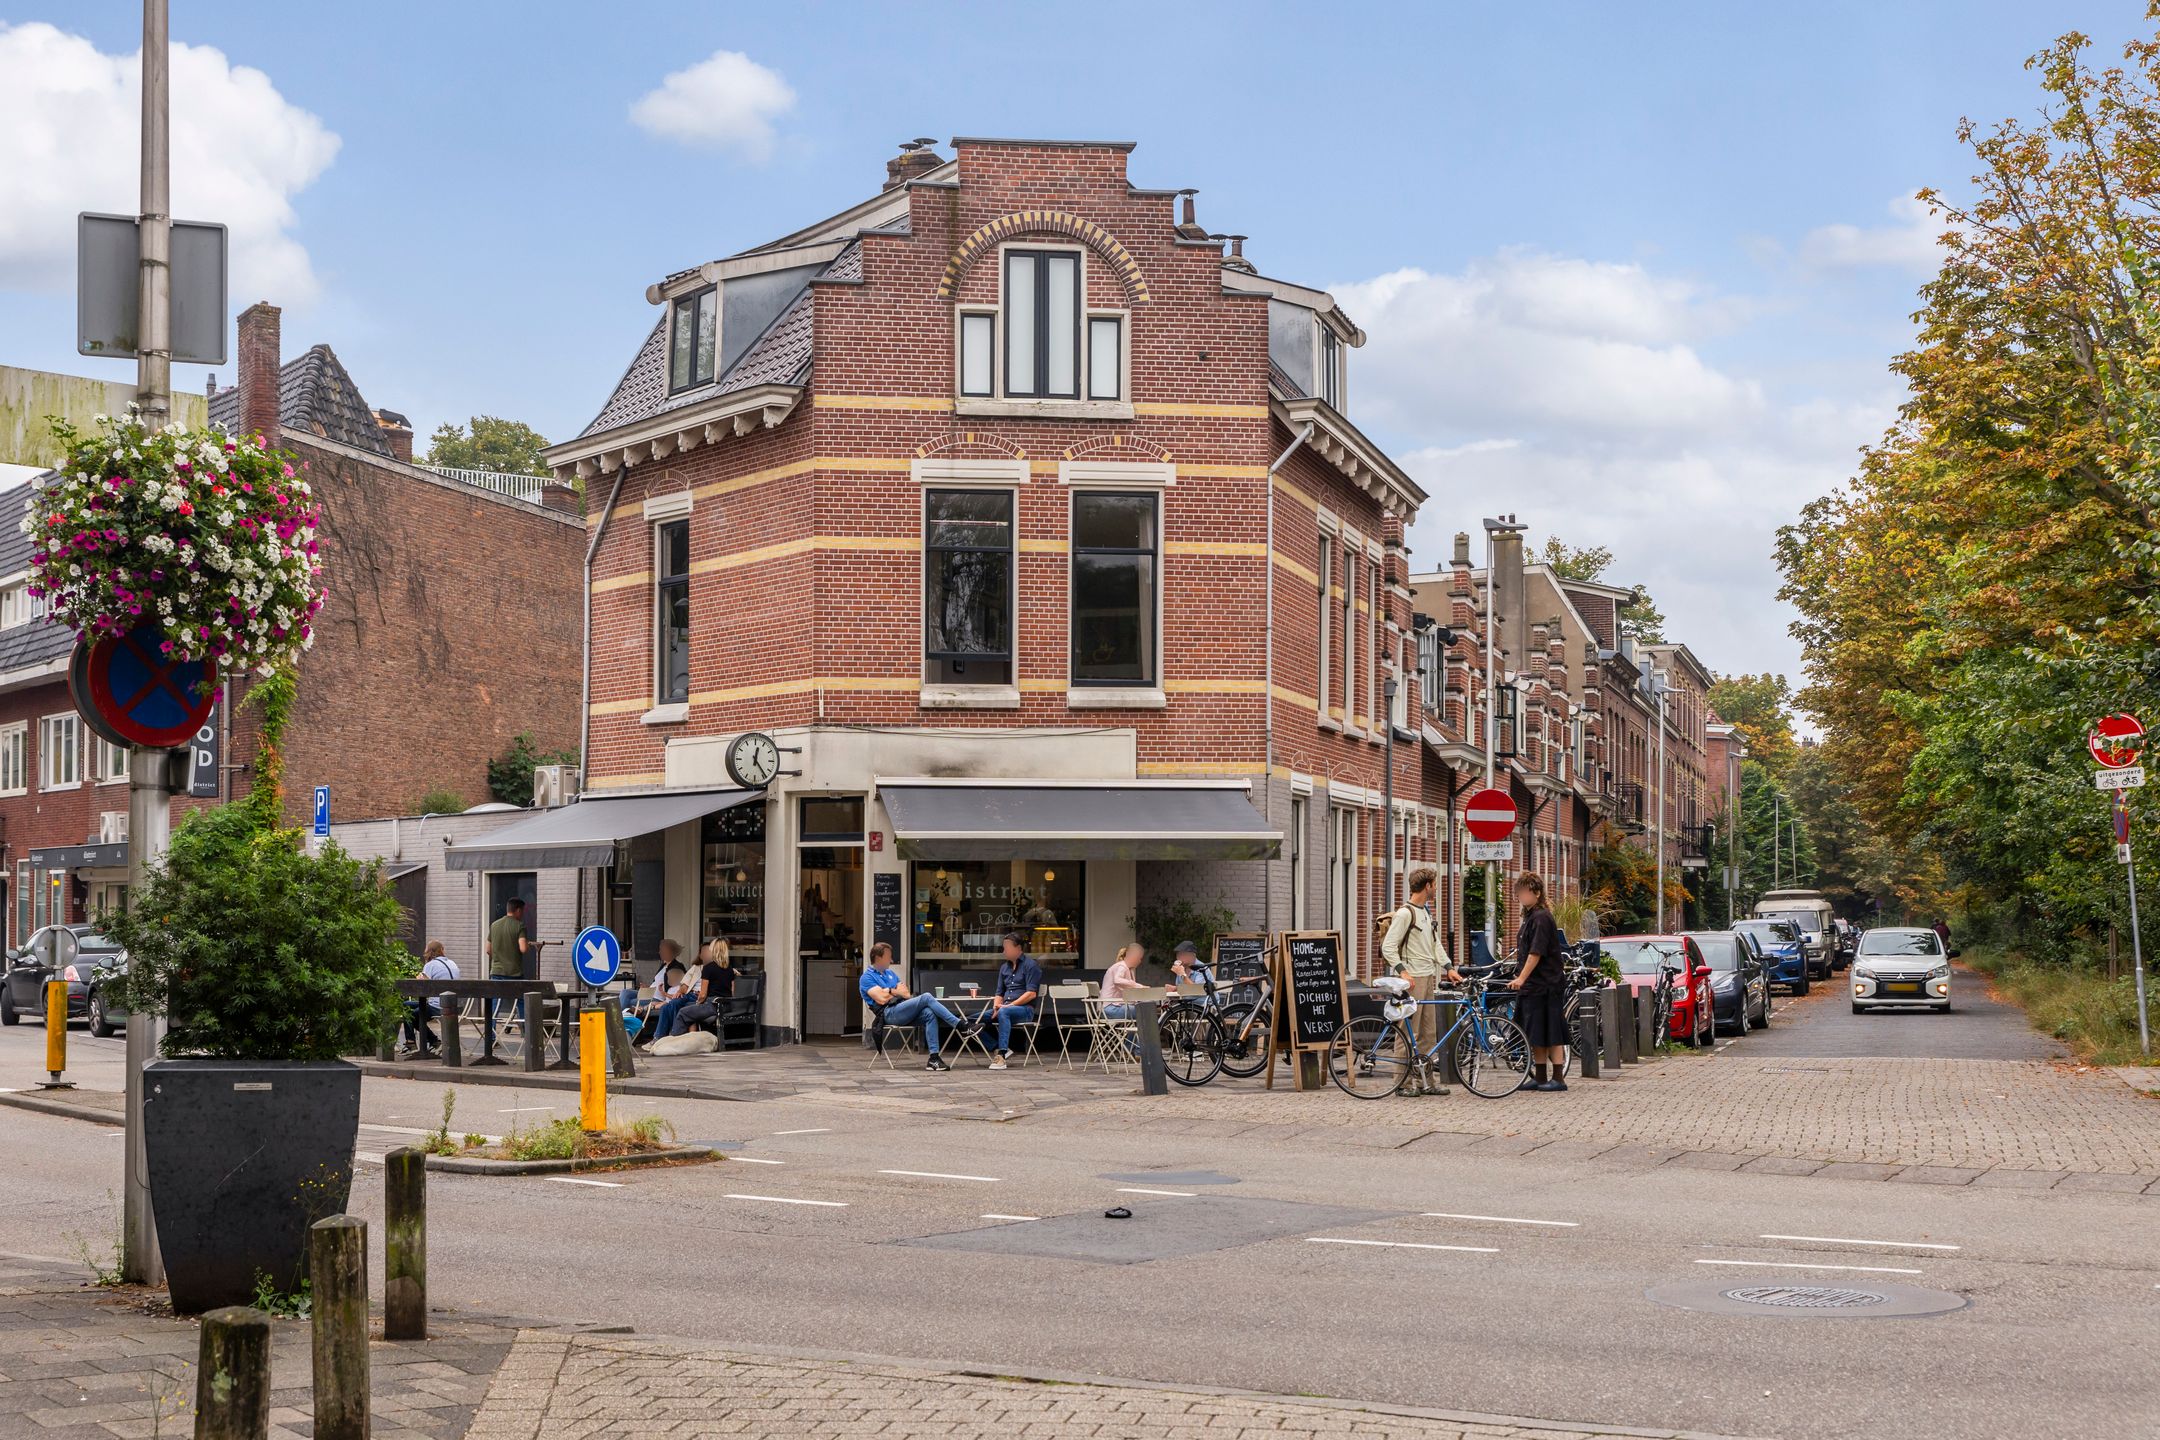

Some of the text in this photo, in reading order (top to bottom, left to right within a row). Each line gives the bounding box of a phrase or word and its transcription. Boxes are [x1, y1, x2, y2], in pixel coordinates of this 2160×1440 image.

[2099, 769, 2141, 778] uitgezonderd
[717, 882, 763, 898] district
[951, 881, 1048, 899] district
[1292, 942, 1315, 955] HOME
[1312, 1004, 1326, 1016] HET
[1303, 1021, 1334, 1035] VERST
